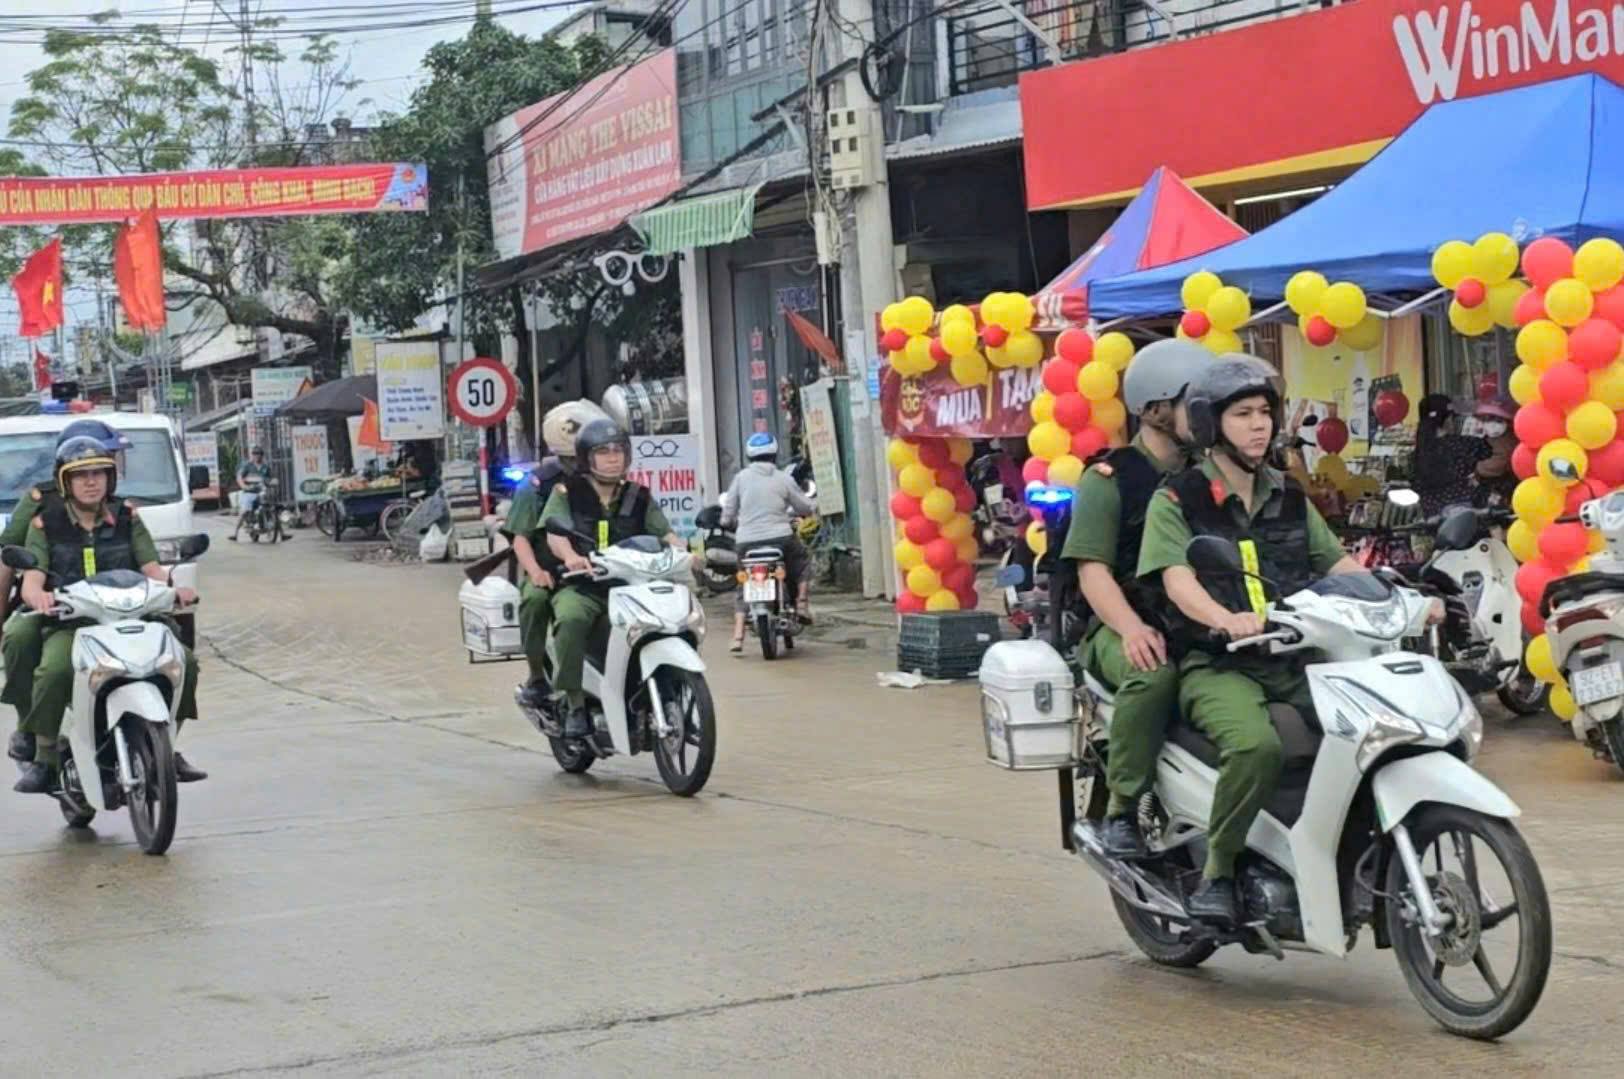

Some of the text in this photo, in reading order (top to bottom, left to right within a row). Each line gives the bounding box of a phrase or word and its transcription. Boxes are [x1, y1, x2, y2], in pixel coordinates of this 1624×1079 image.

[468, 378, 495, 407] 50
[936, 387, 982, 428] MUA
[659, 464, 695, 492] KÍNH
[656, 495, 694, 512] PTIC
